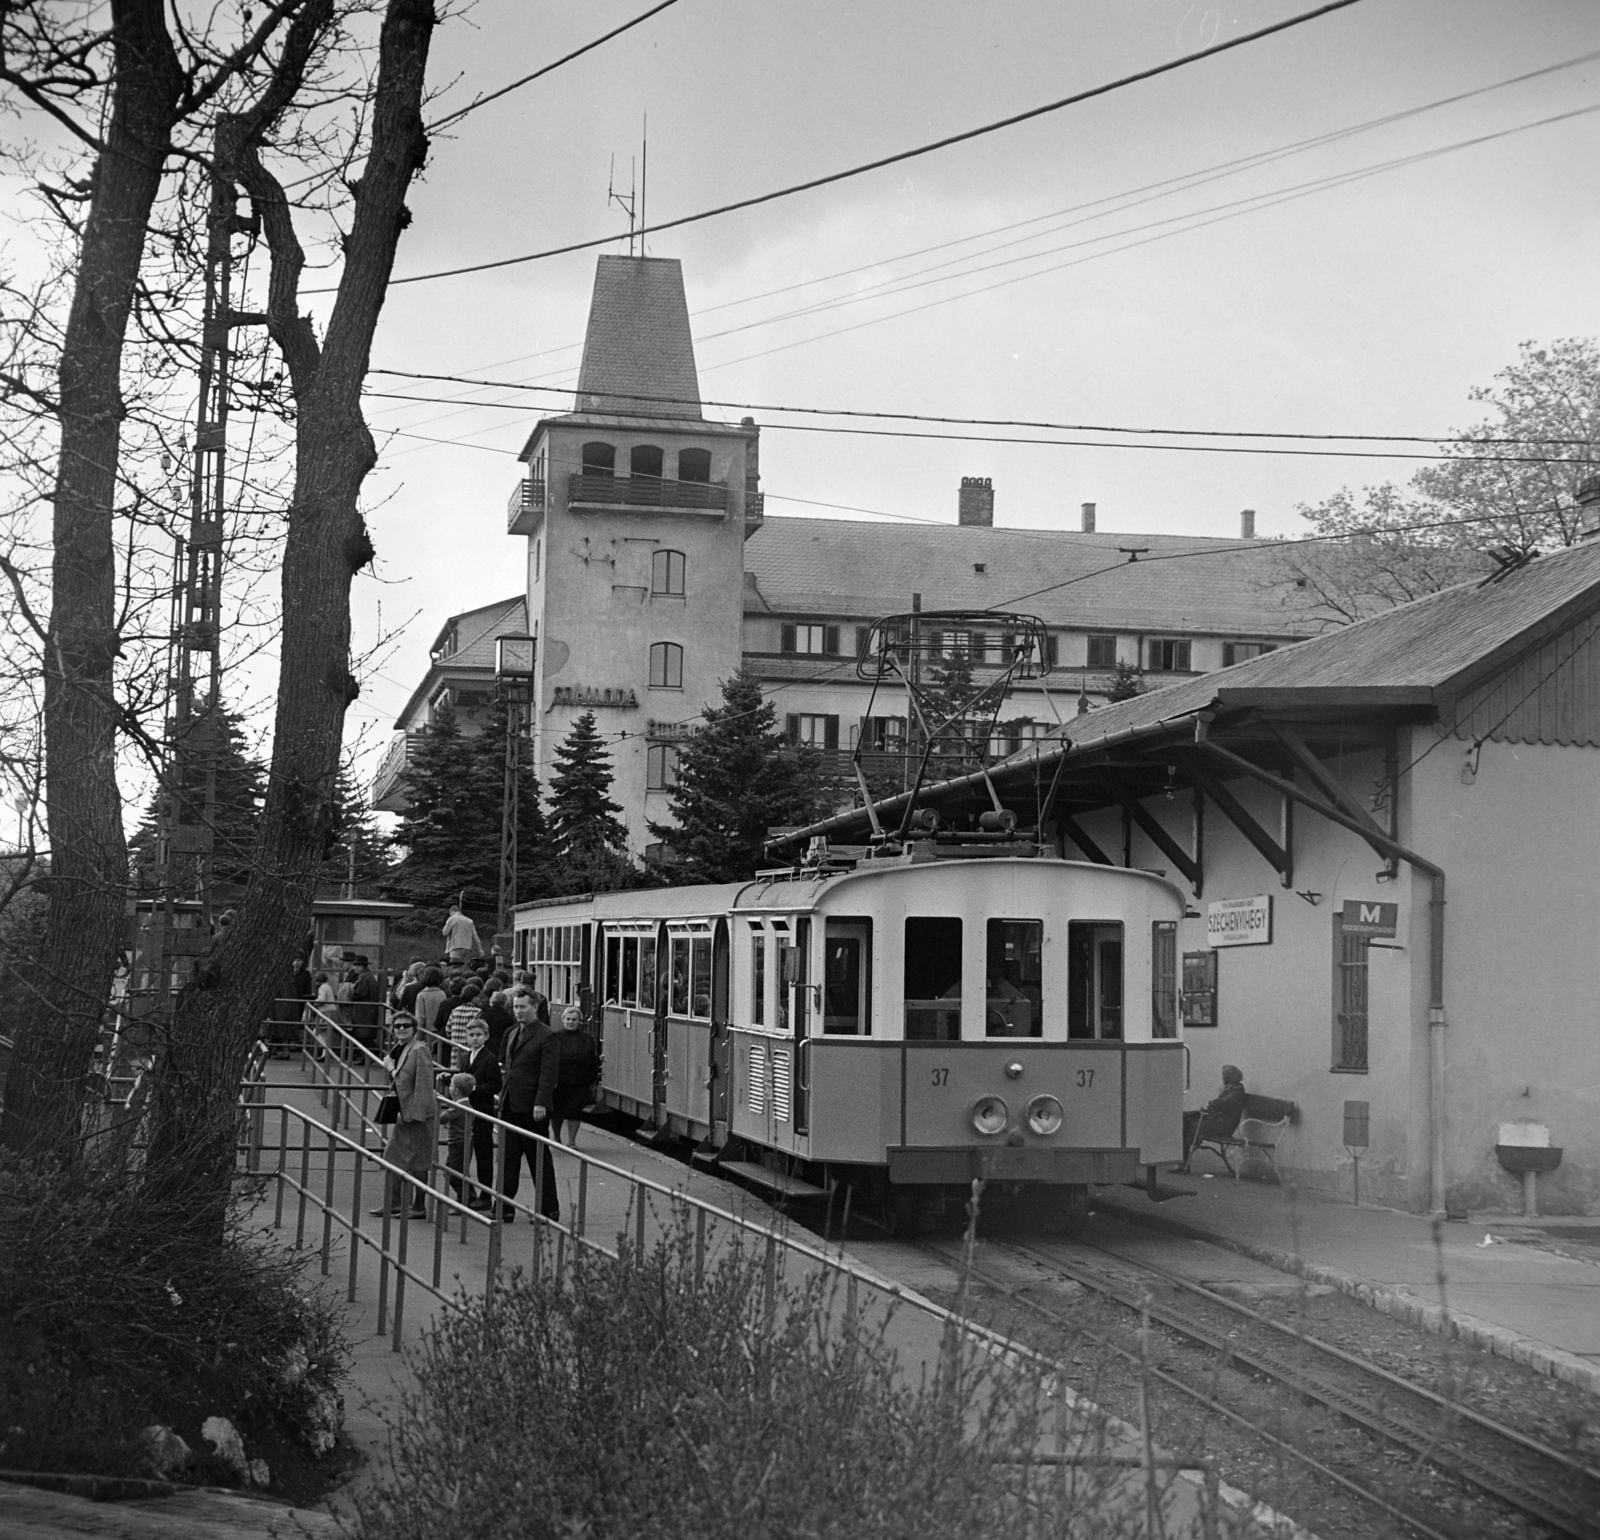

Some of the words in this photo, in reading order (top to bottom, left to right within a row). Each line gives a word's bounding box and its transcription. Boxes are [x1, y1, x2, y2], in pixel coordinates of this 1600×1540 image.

[1208, 908, 1267, 933] SZÉCHENYIHEGY
[1360, 903, 1381, 923] M
[931, 1068, 950, 1087] 37
[1077, 1069, 1095, 1088] 37
